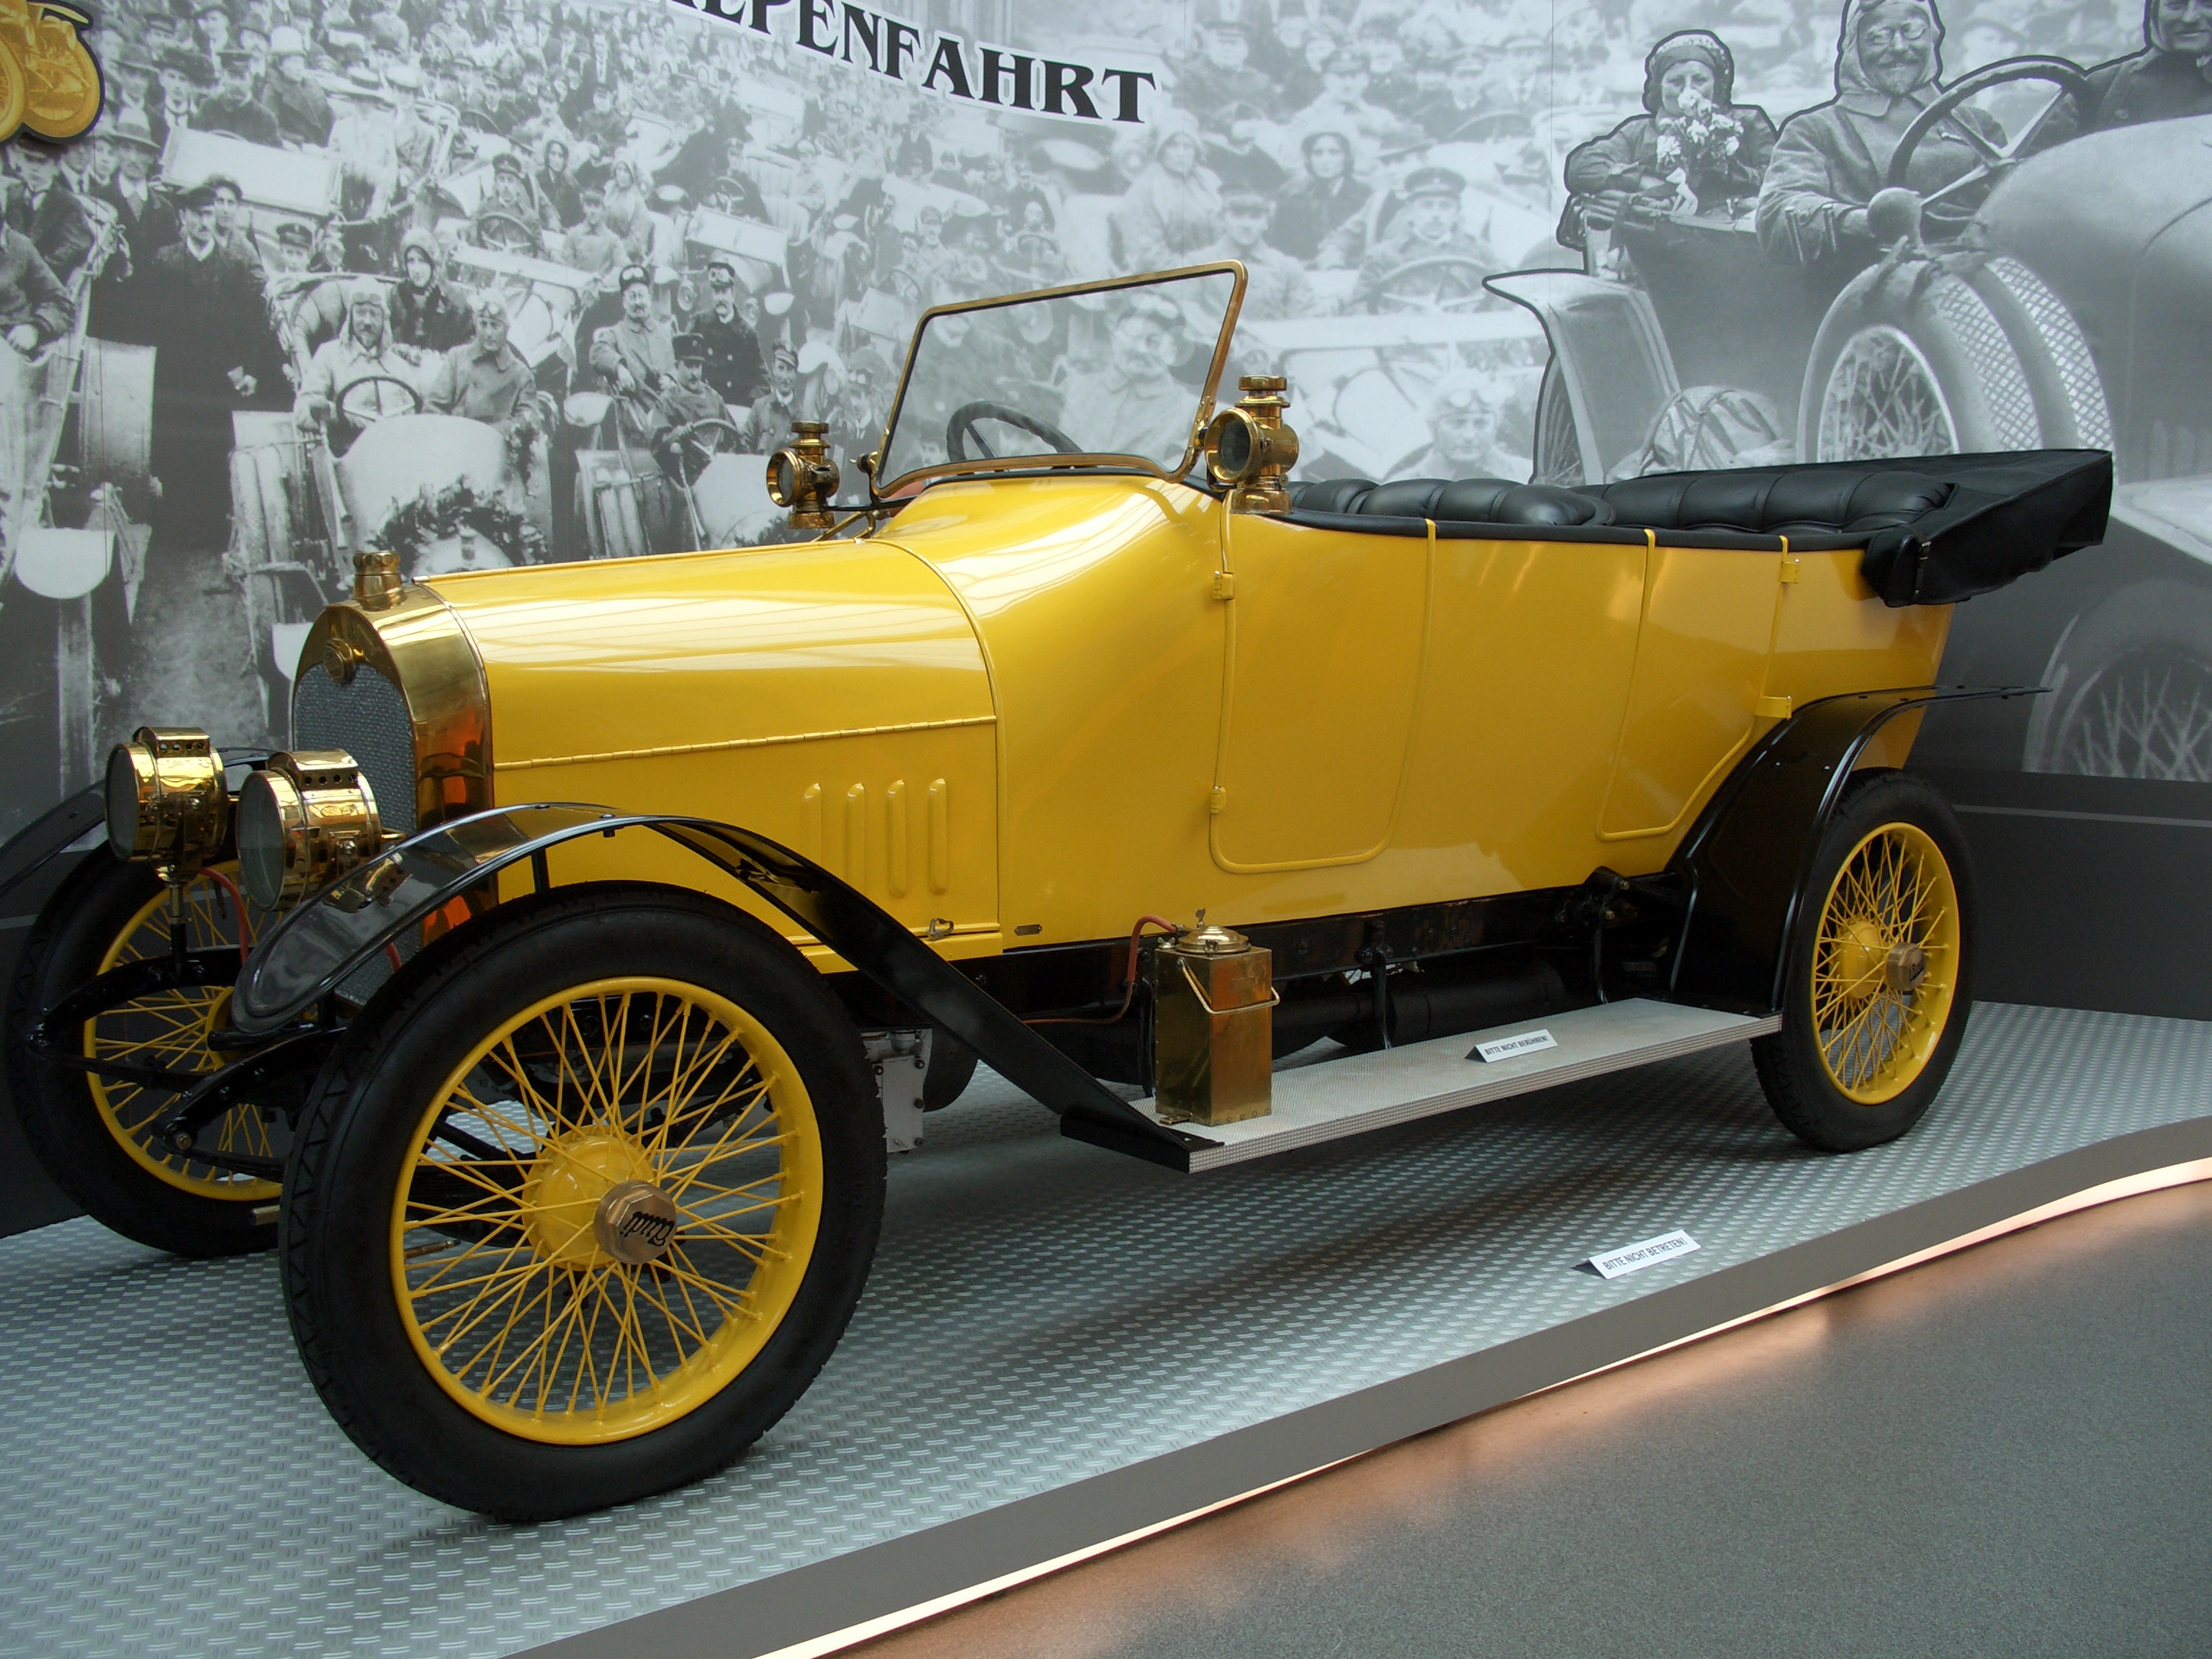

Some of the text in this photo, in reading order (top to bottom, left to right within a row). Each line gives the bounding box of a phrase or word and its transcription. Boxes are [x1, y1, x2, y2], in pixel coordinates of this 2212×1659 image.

[1484, 1046, 1501, 1056] BITTE
[1501, 1043, 1519, 1051] NICHT
[620, 1211, 675, 1246] Audi
[1602, 1236, 1688, 1270] BITTE NICHT BETRETEN!
